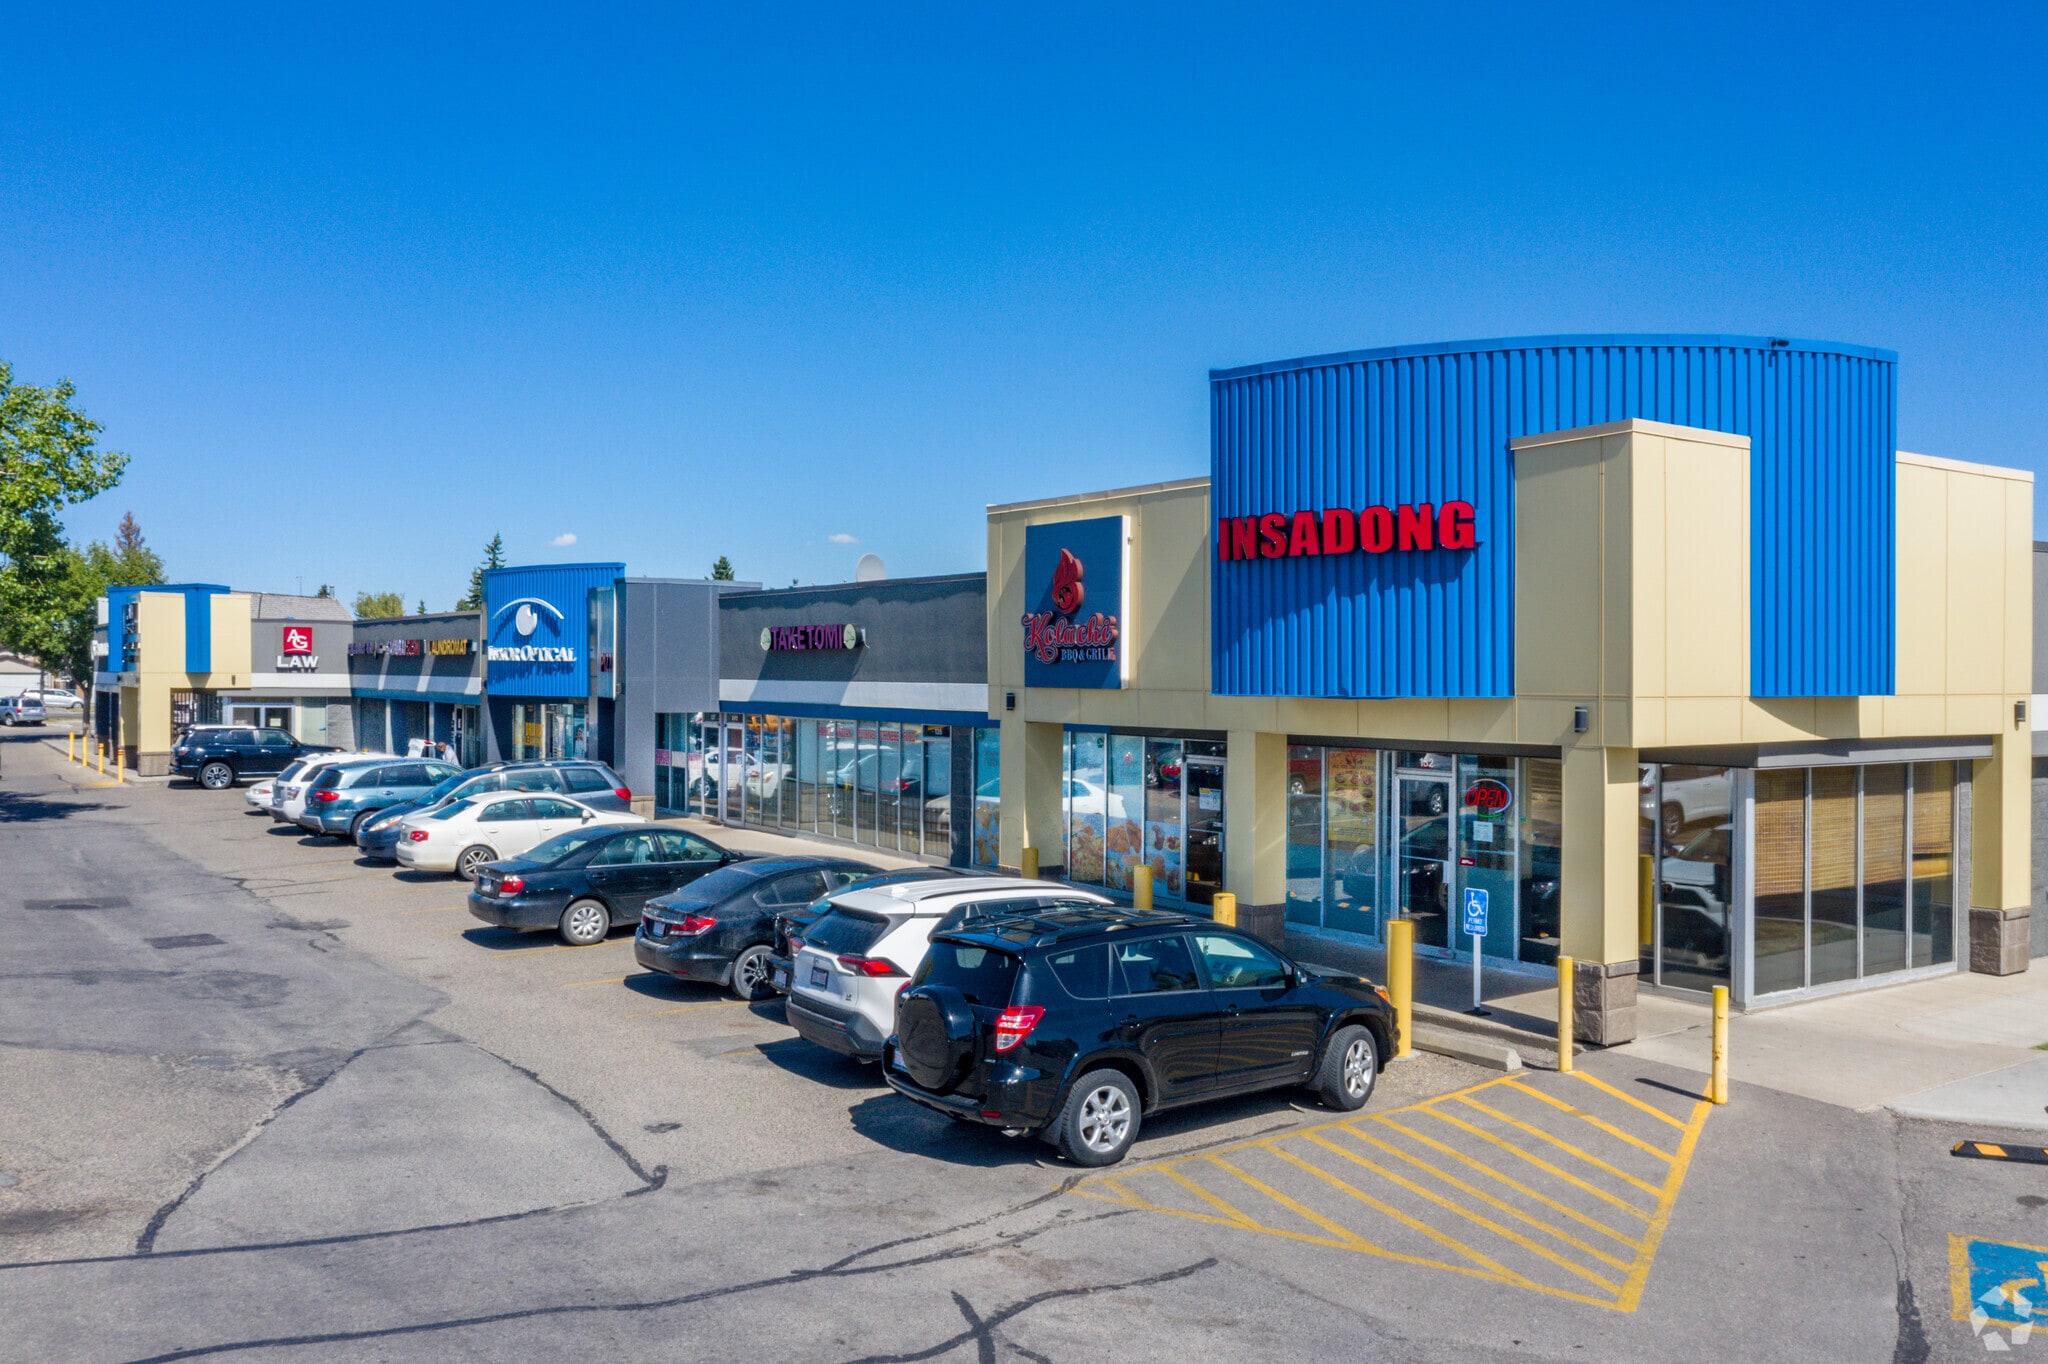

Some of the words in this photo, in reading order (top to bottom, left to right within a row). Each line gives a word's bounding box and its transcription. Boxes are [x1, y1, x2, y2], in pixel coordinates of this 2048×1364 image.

[1218, 500, 1475, 561] INSADONG
[286, 629, 308, 649] AG
[428, 639, 468, 656] LAUNDROMAT
[771, 624, 843, 651] TAKETOMI
[1021, 611, 1114, 664] Kolachi
[276, 656, 319, 668] LAW
[1465, 787, 1508, 808] OPEN
